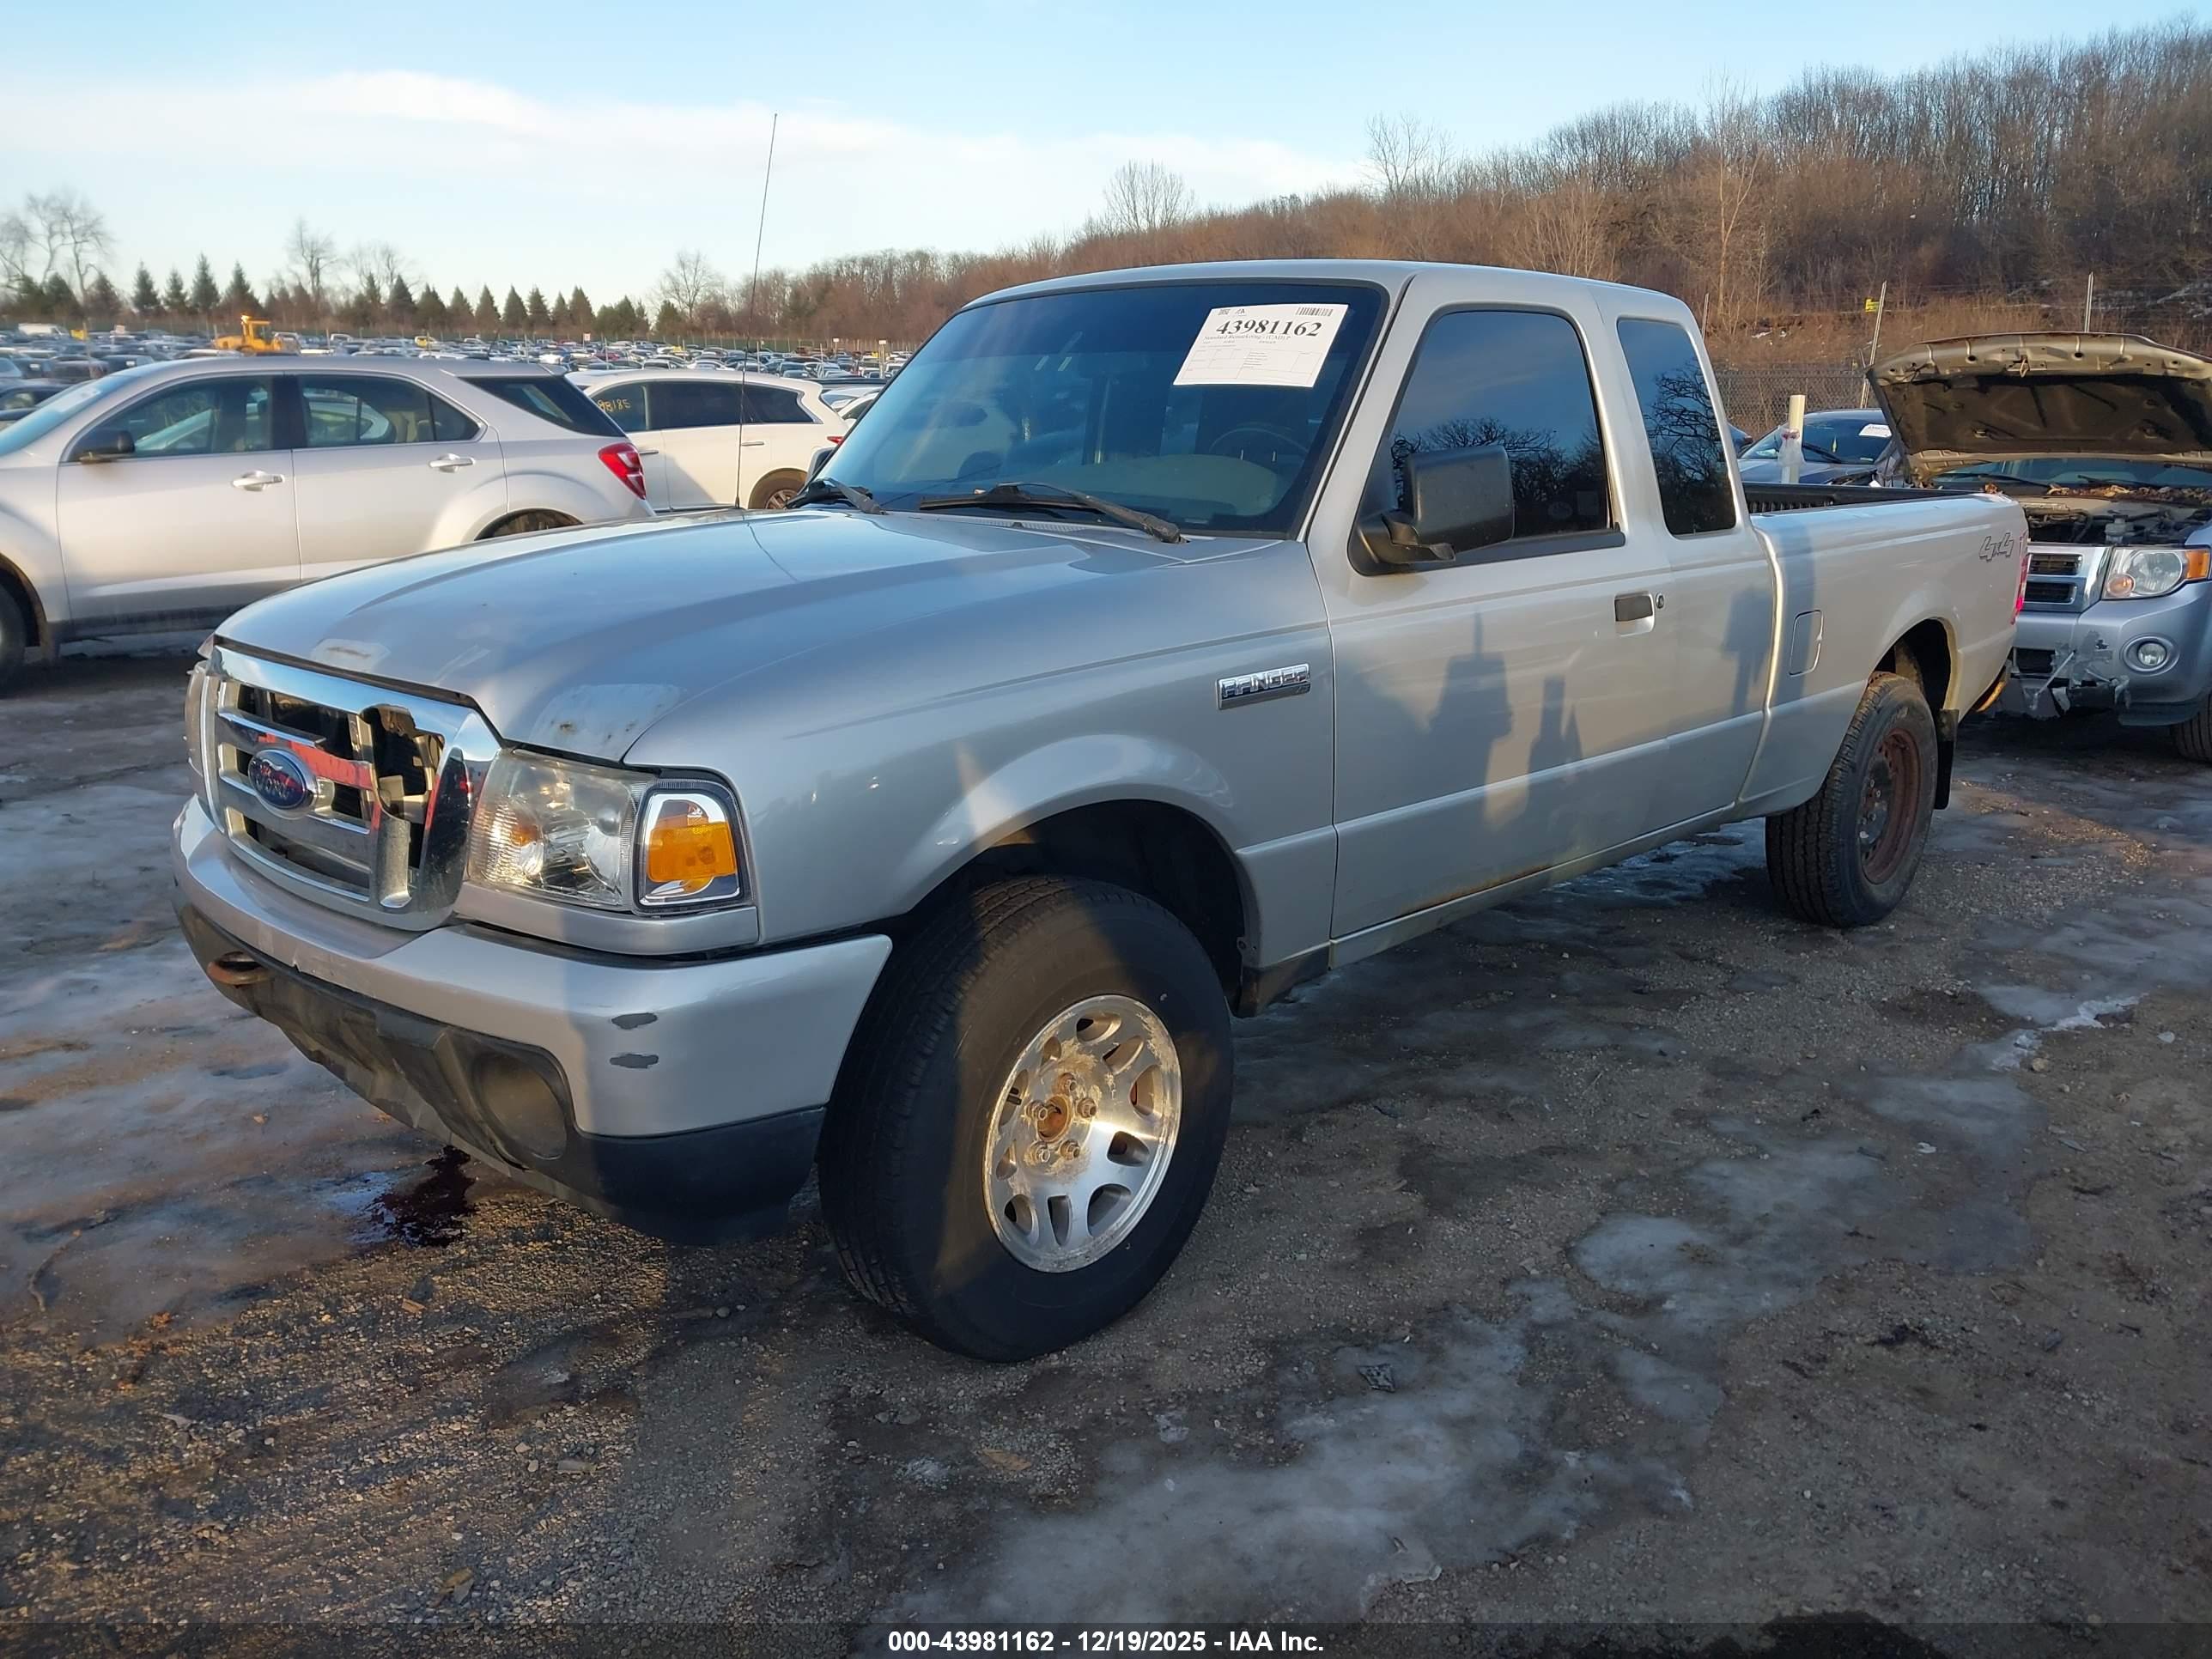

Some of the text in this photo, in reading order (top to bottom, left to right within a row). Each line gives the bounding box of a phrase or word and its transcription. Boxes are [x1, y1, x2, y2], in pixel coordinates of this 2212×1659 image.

[1215, 319, 1322, 337] 43981162
[1978, 531, 2014, 562] 4x4
[1221, 665, 1309, 698] RANGER
